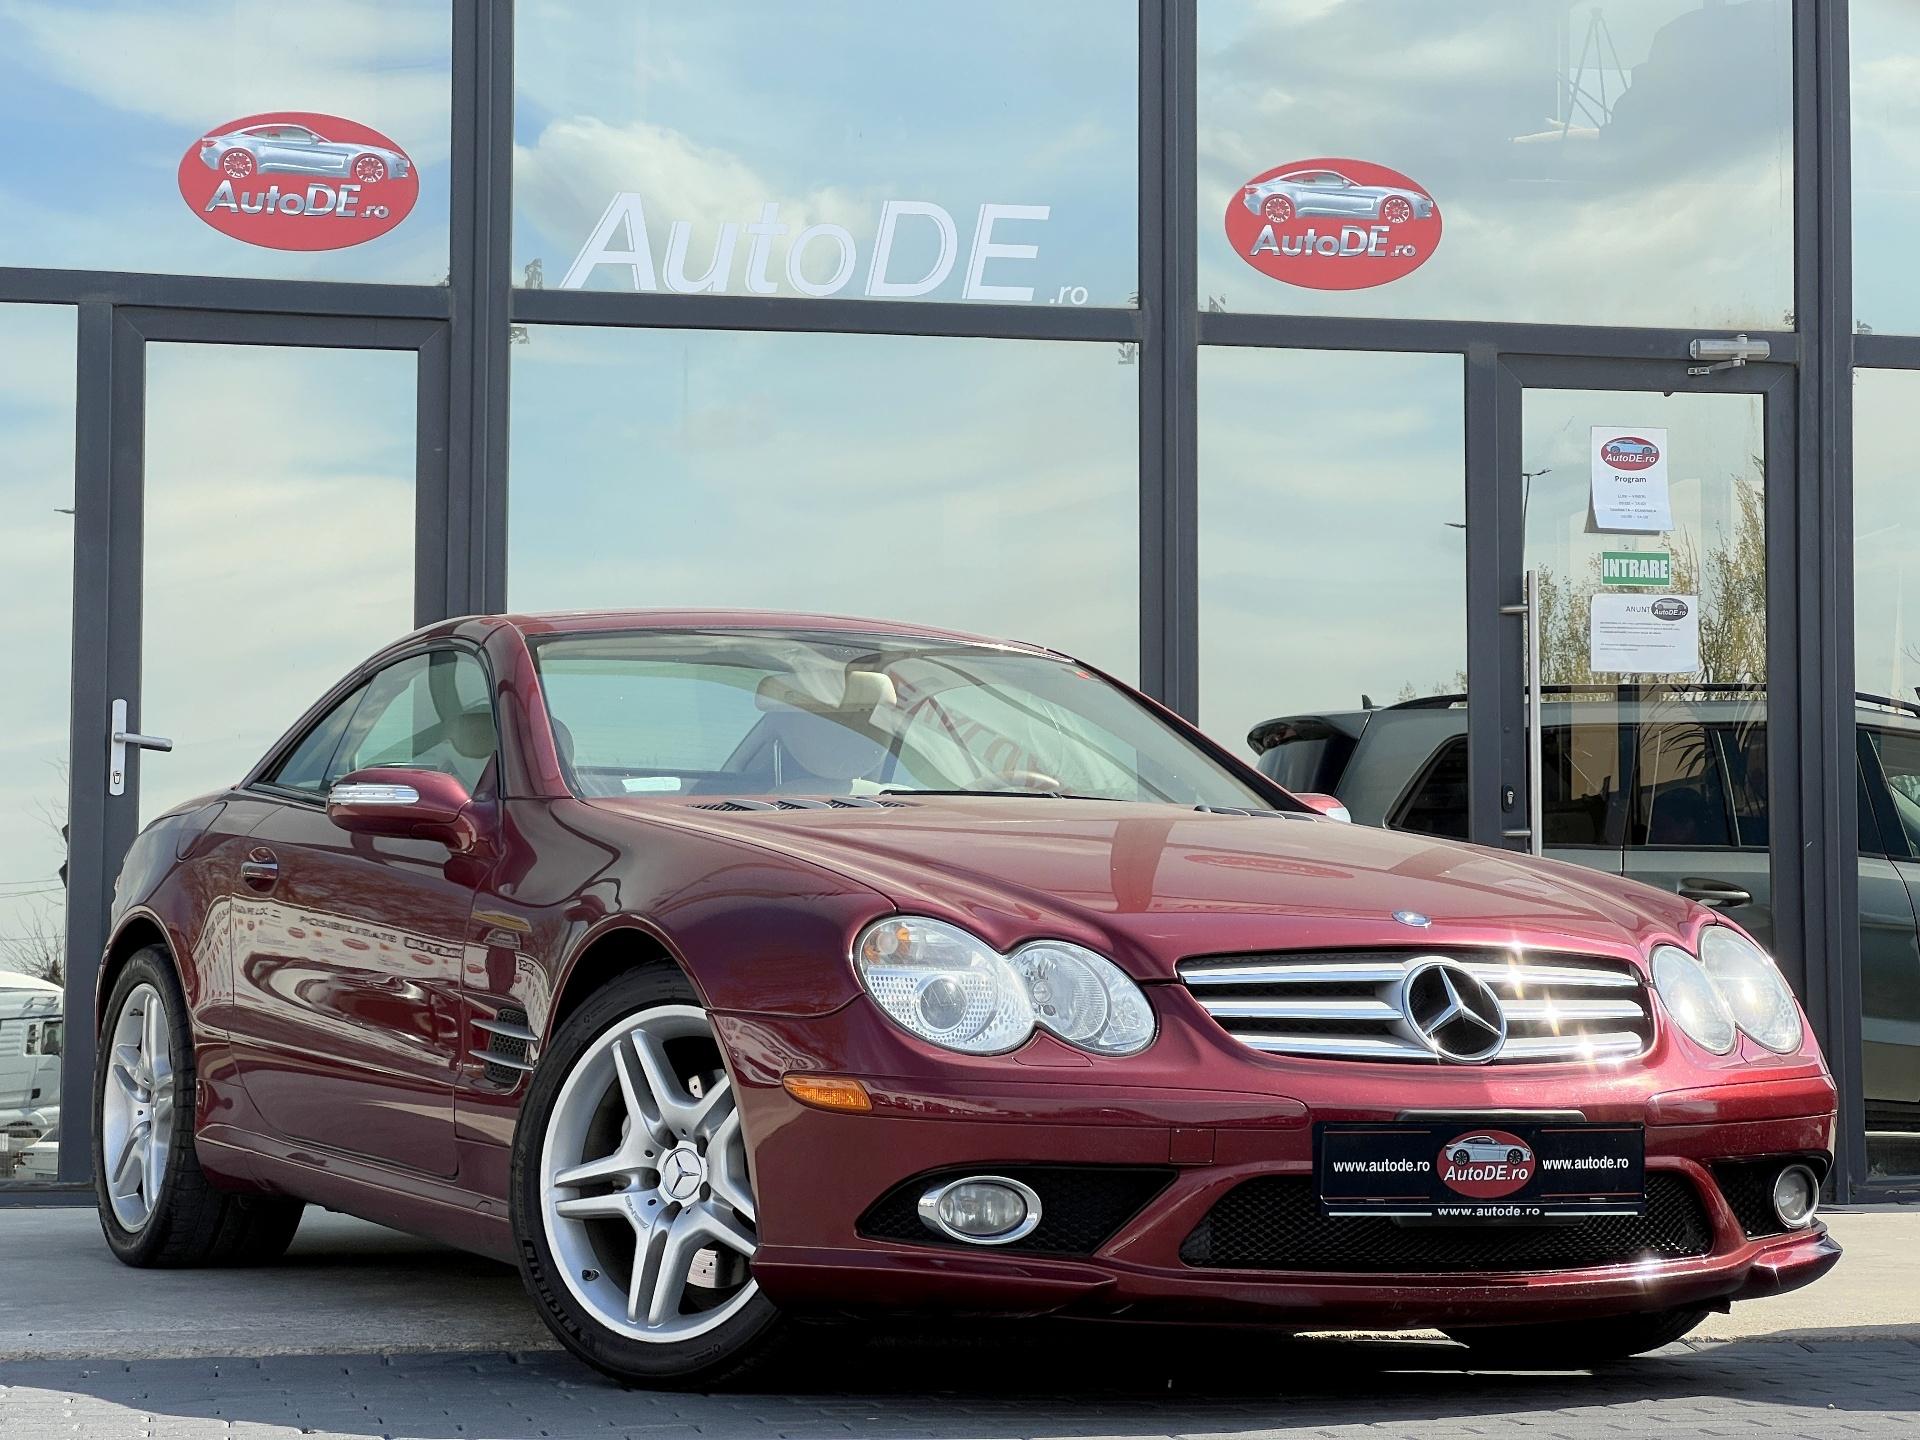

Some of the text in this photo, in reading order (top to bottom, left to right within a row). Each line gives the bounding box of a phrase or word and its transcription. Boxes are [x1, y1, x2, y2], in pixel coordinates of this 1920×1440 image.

[1605, 453, 1656, 463] AutoDE.ro
[1614, 475, 1647, 483] Program
[1603, 558, 1669, 578] INTRARE
[1333, 1159, 1430, 1172] www.autode.ro
[1542, 1156, 1629, 1171] www.autode.ro
[1444, 1165, 1528, 1182] AutoDE.ro
[1437, 1205, 1540, 1216] www.autode.ro
